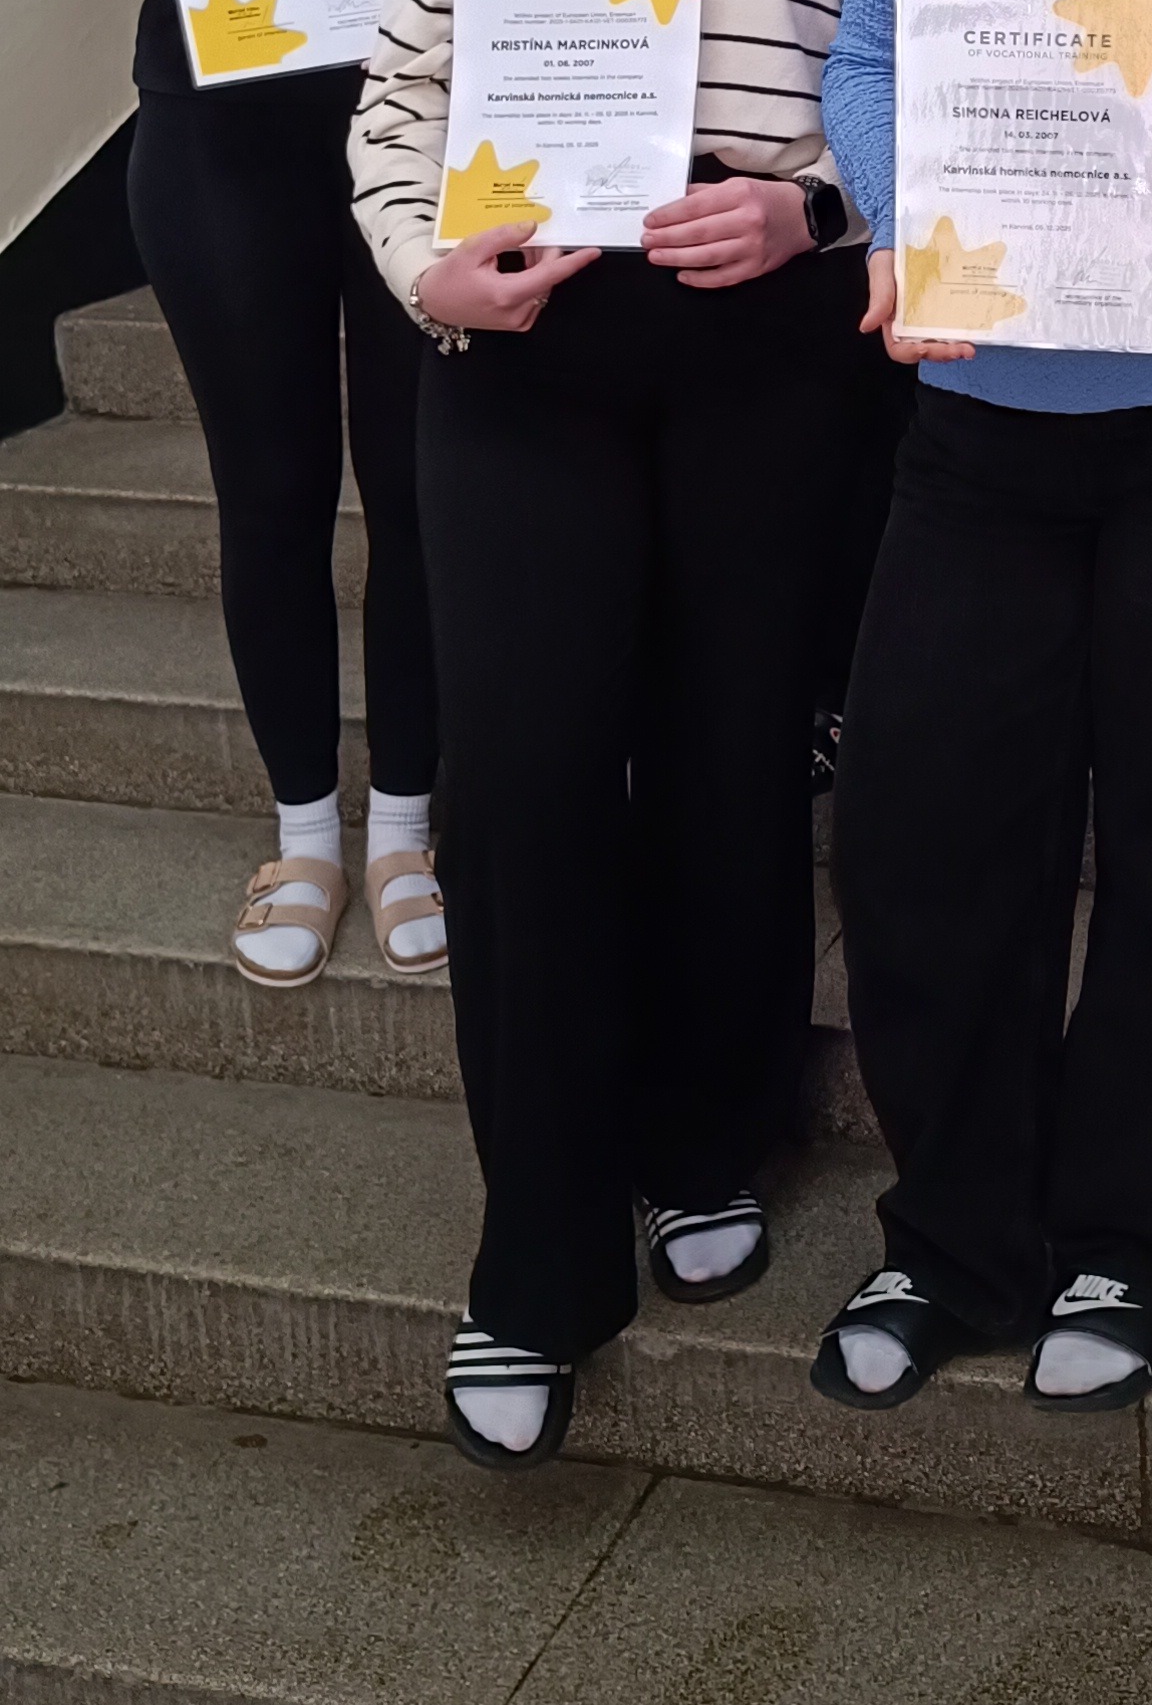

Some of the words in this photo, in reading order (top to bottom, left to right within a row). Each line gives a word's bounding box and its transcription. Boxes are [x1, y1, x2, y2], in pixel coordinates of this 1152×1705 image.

[492, 37, 552, 51] KRISTÍNA
[557, 36, 649, 50] MARCINKOVÁ
[964, 30, 1112, 48] CERTIFICATE
[968, 49, 982, 57] OF
[986, 49, 1054, 60] VOCATIONAL
[1059, 52, 1107, 60] TRAINING
[488, 92, 535, 102] Karvinská
[538, 92, 581, 101] hornická
[584, 91, 637, 100] nemocnice
[952, 106, 1010, 119] SIMONA
[1016, 108, 1111, 122] REICHELOVÁ
[943, 164, 996, 176] Karvinská
[1000, 166, 1047, 177] hornická
[1066, 1274, 1129, 1301] NIKE
